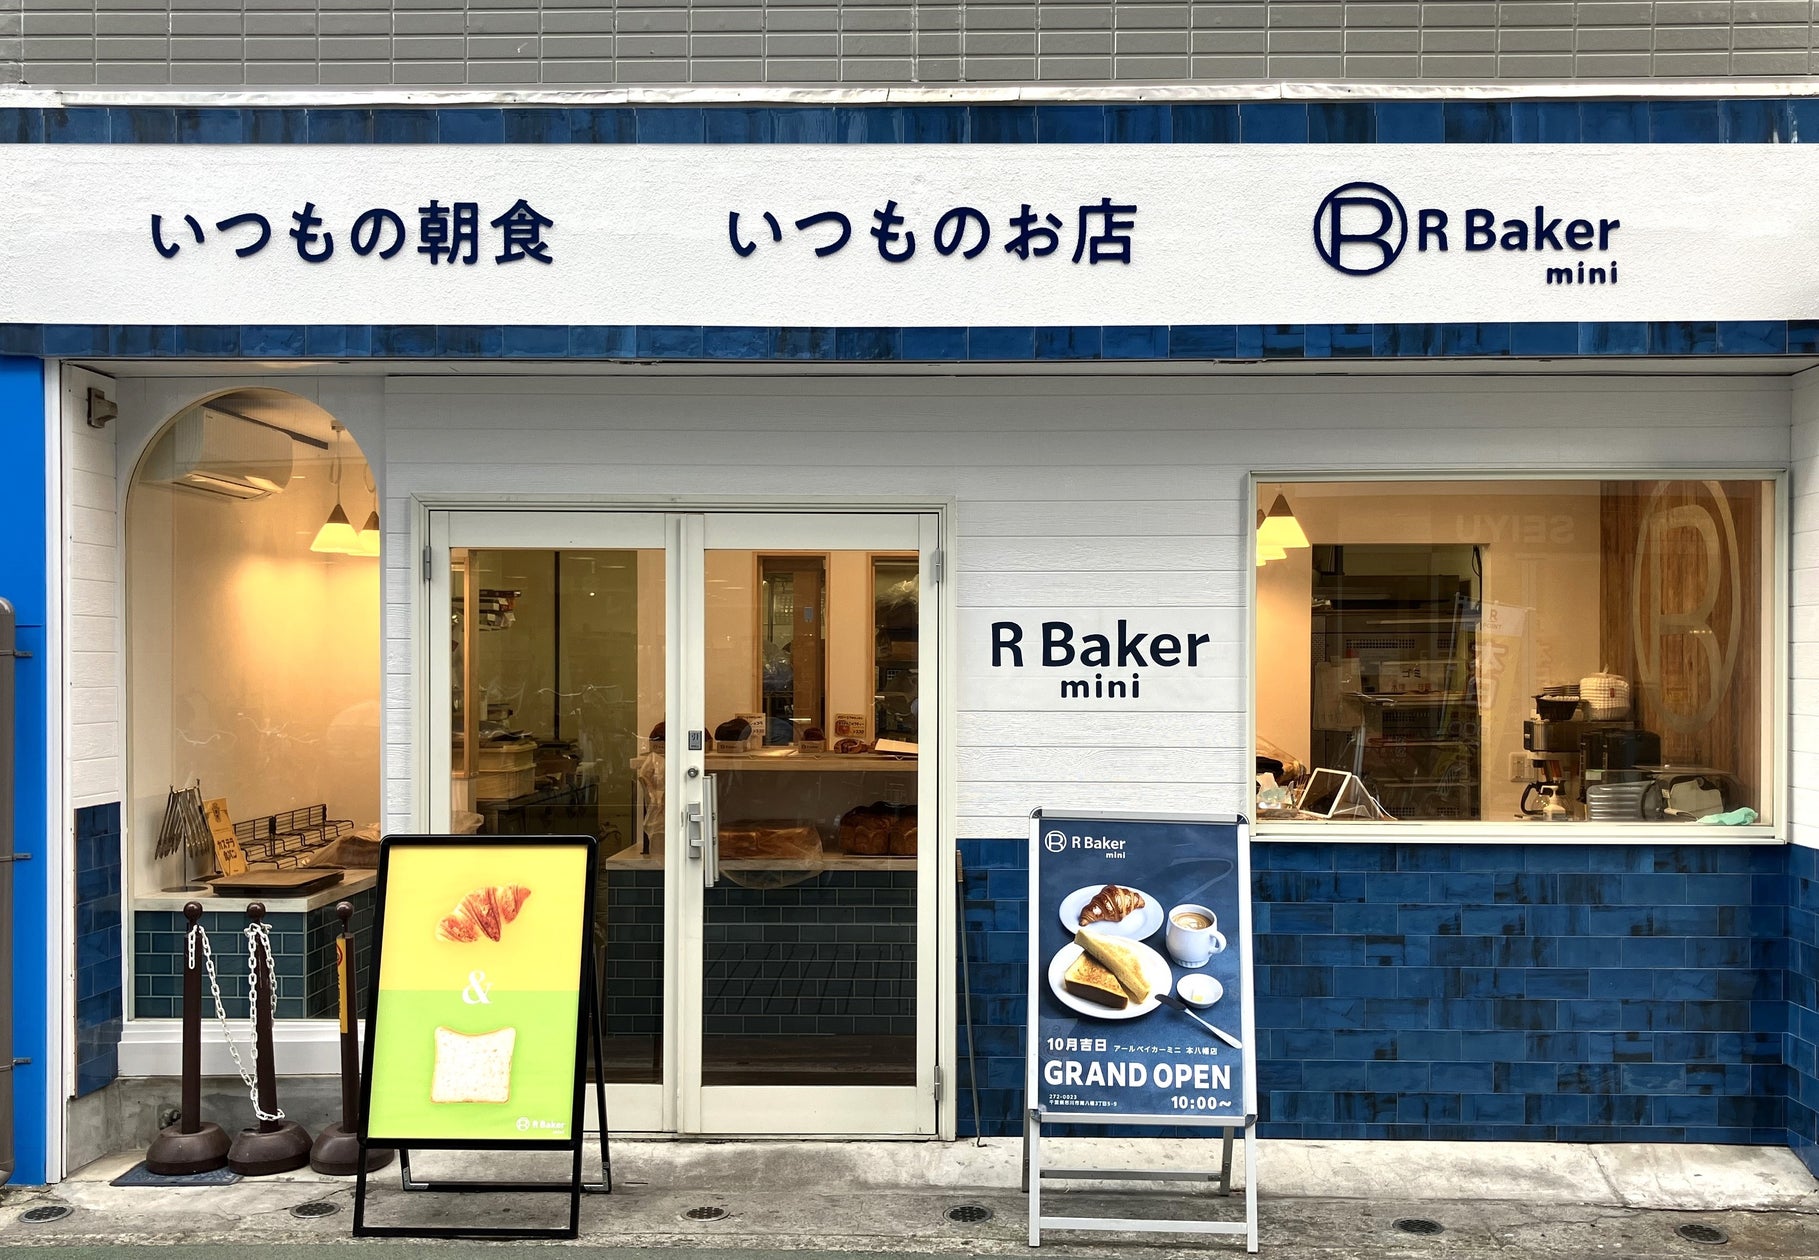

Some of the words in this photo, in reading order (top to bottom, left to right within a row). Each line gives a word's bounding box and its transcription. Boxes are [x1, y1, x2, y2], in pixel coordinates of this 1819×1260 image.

[151, 199, 554, 265] いつもの朝食
[728, 197, 1138, 264] いつものお店
[1418, 208, 1449, 251] R
[1465, 205, 1621, 251] Baker
[1547, 261, 1617, 284] mini
[991, 621, 1024, 667] R
[1042, 619, 1210, 667] Baker
[1061, 673, 1139, 698] mini
[1072, 836, 1081, 849] R
[1084, 835, 1126, 850] Baker
[1106, 851, 1126, 859] mini
[461, 970, 494, 1005] &
[1047, 1037, 1107, 1052] 10月吉日
[1044, 1060, 1147, 1088] GRAND
[1153, 1062, 1231, 1090] OPEN
